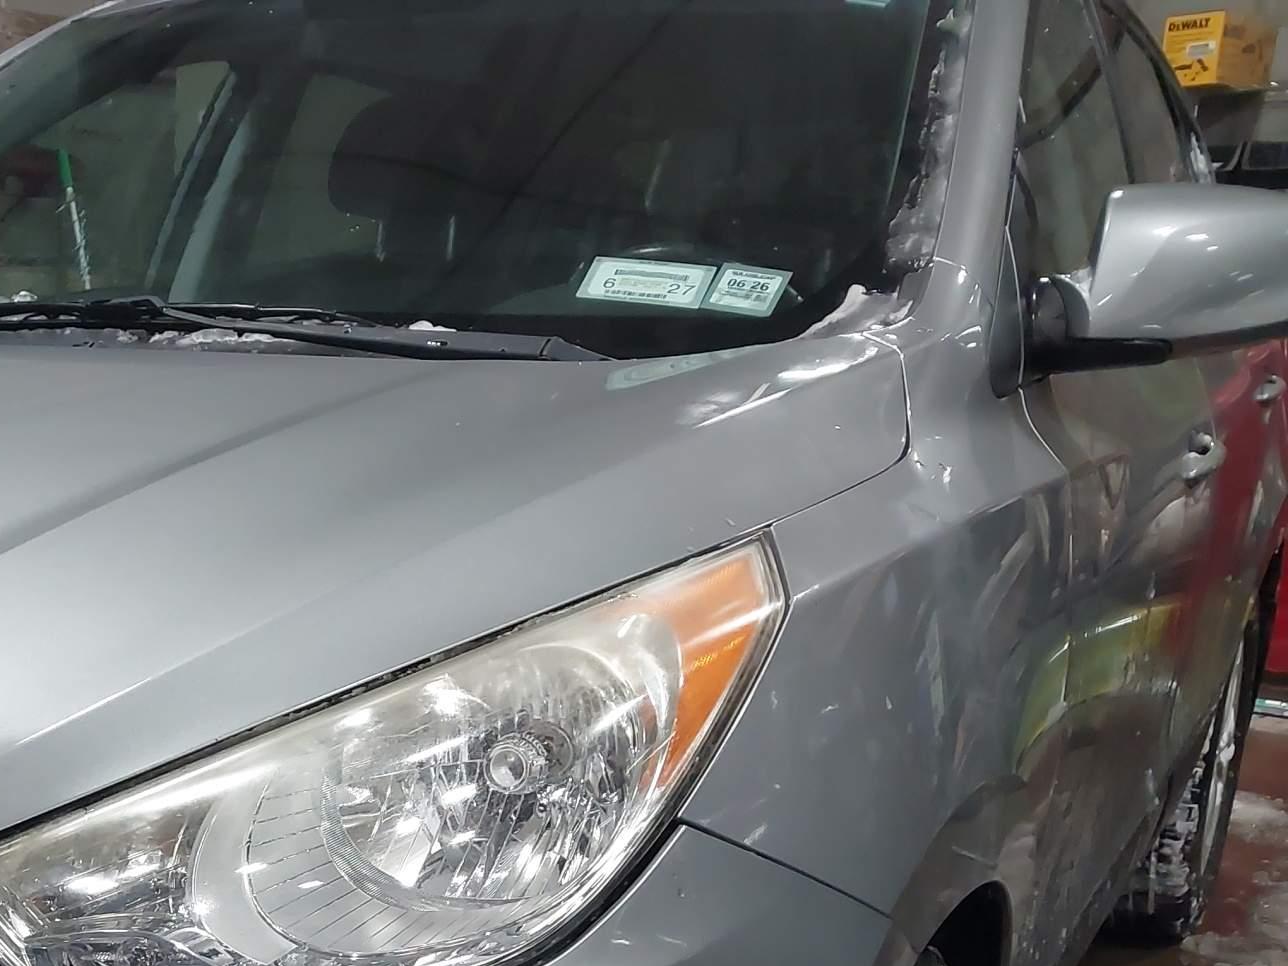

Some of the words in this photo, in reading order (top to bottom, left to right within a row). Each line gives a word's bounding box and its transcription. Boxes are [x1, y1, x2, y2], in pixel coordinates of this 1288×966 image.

[602, 278, 617, 289] 6
[666, 283, 697, 296] 27
[727, 278, 746, 288] 06
[750, 280, 770, 292] 26
